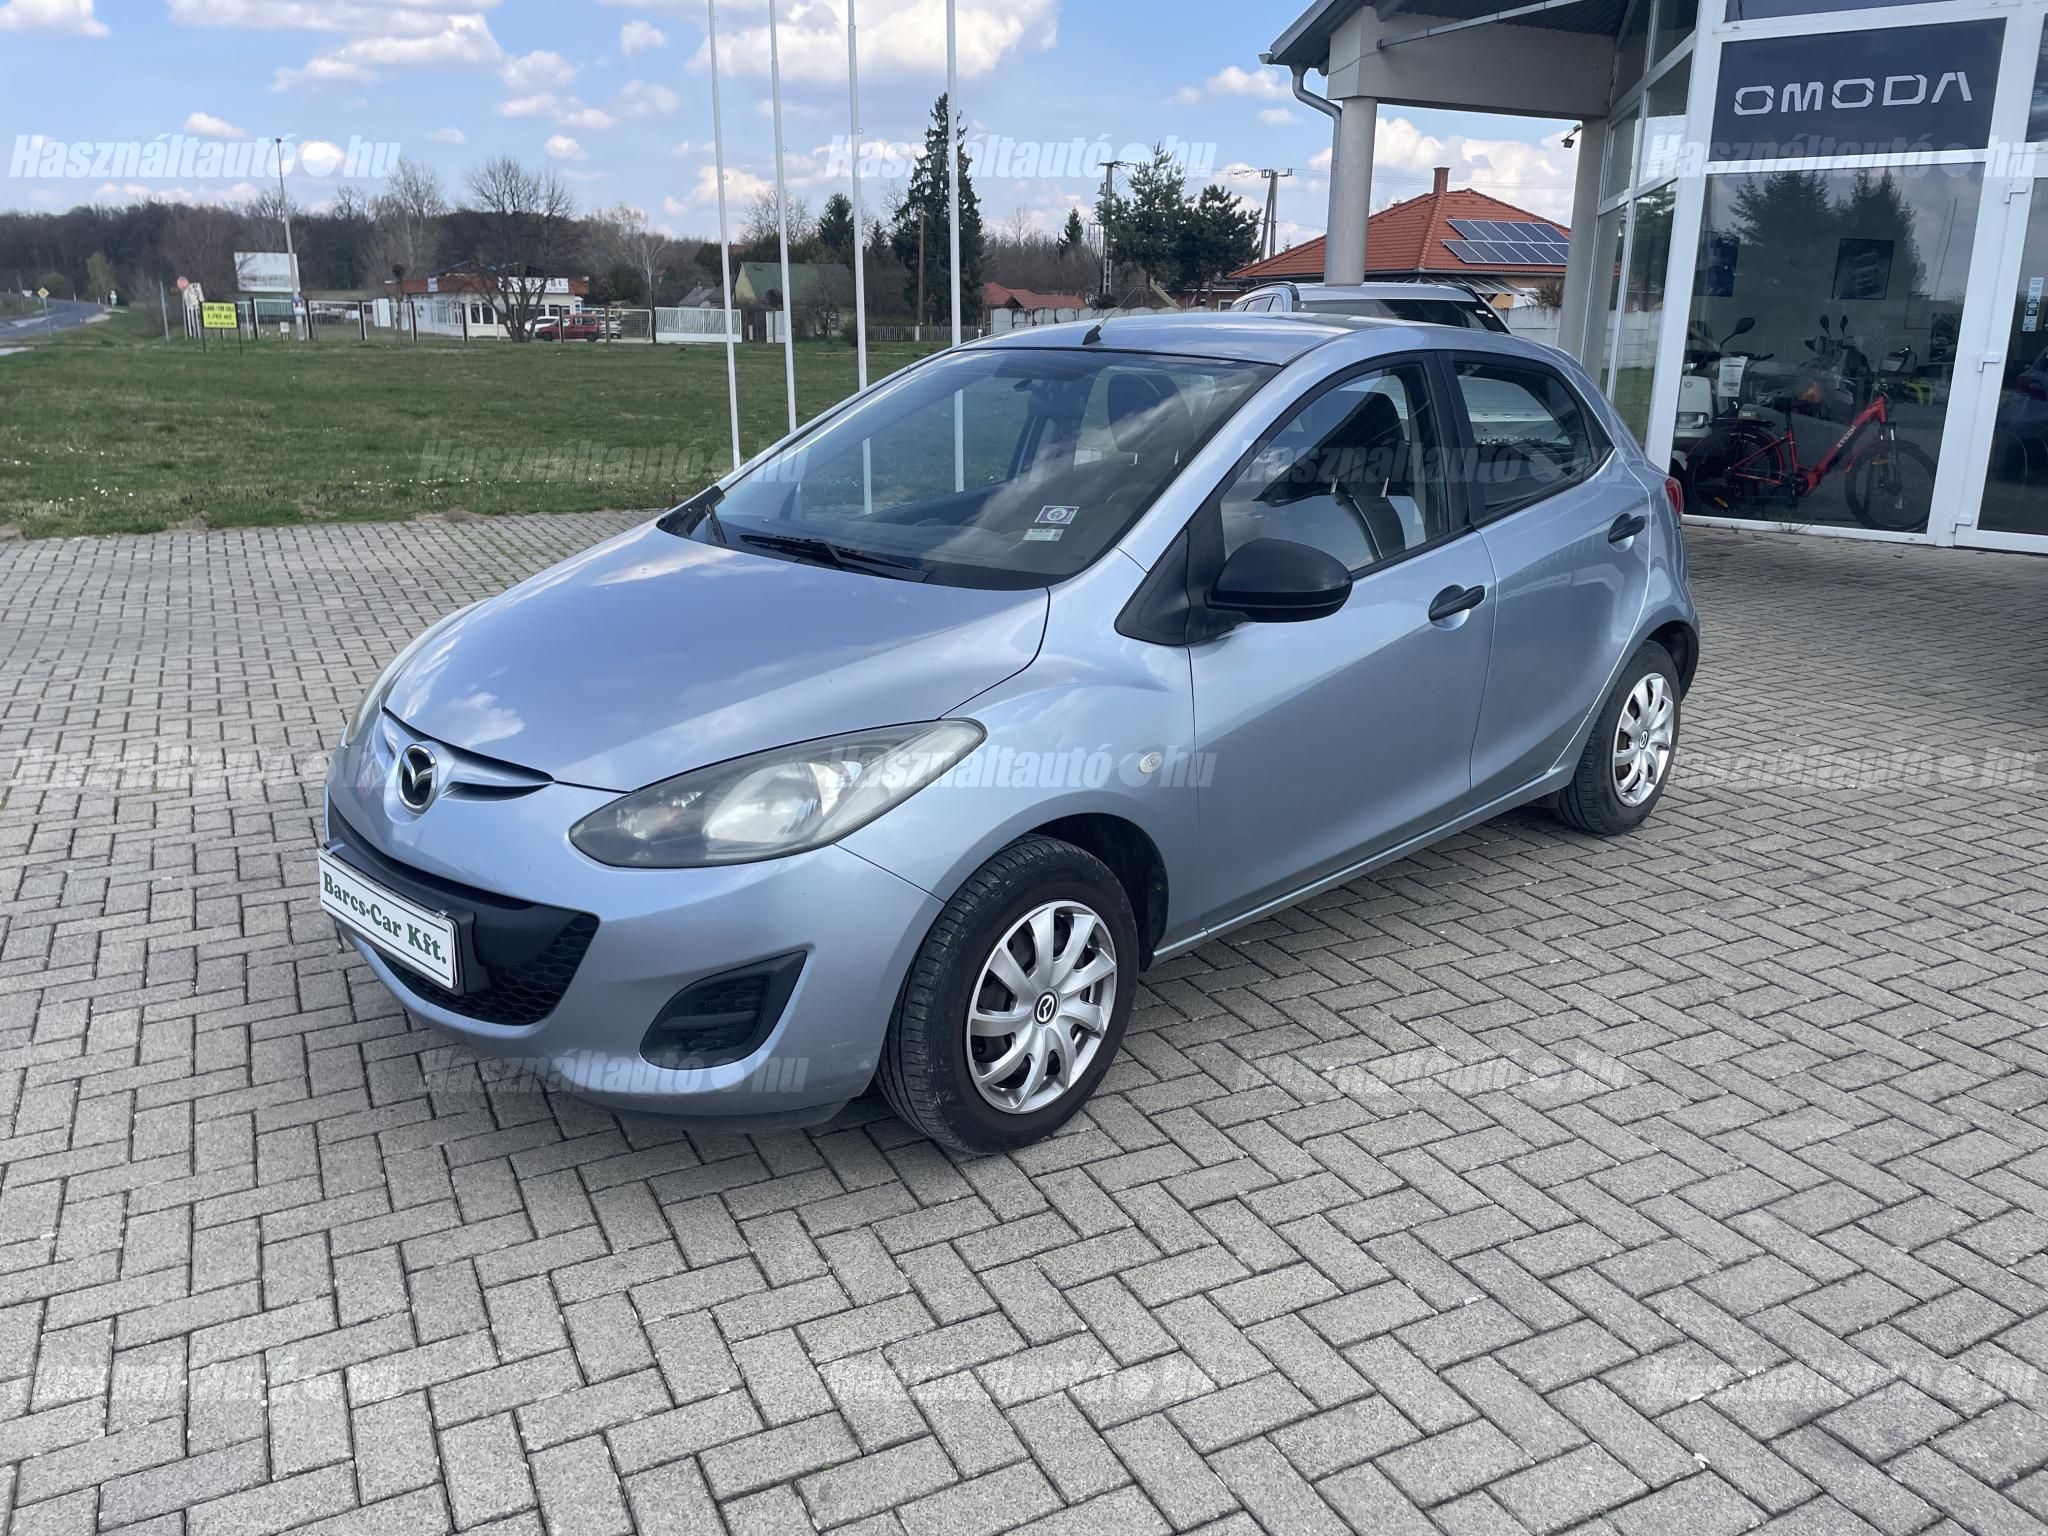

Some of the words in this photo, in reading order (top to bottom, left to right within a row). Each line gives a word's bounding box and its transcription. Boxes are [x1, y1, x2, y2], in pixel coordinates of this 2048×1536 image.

[1734, 72, 1972, 116] OMODA
[323, 871, 402, 938] Barcs-Car
[407, 922, 447, 964] Kft.
